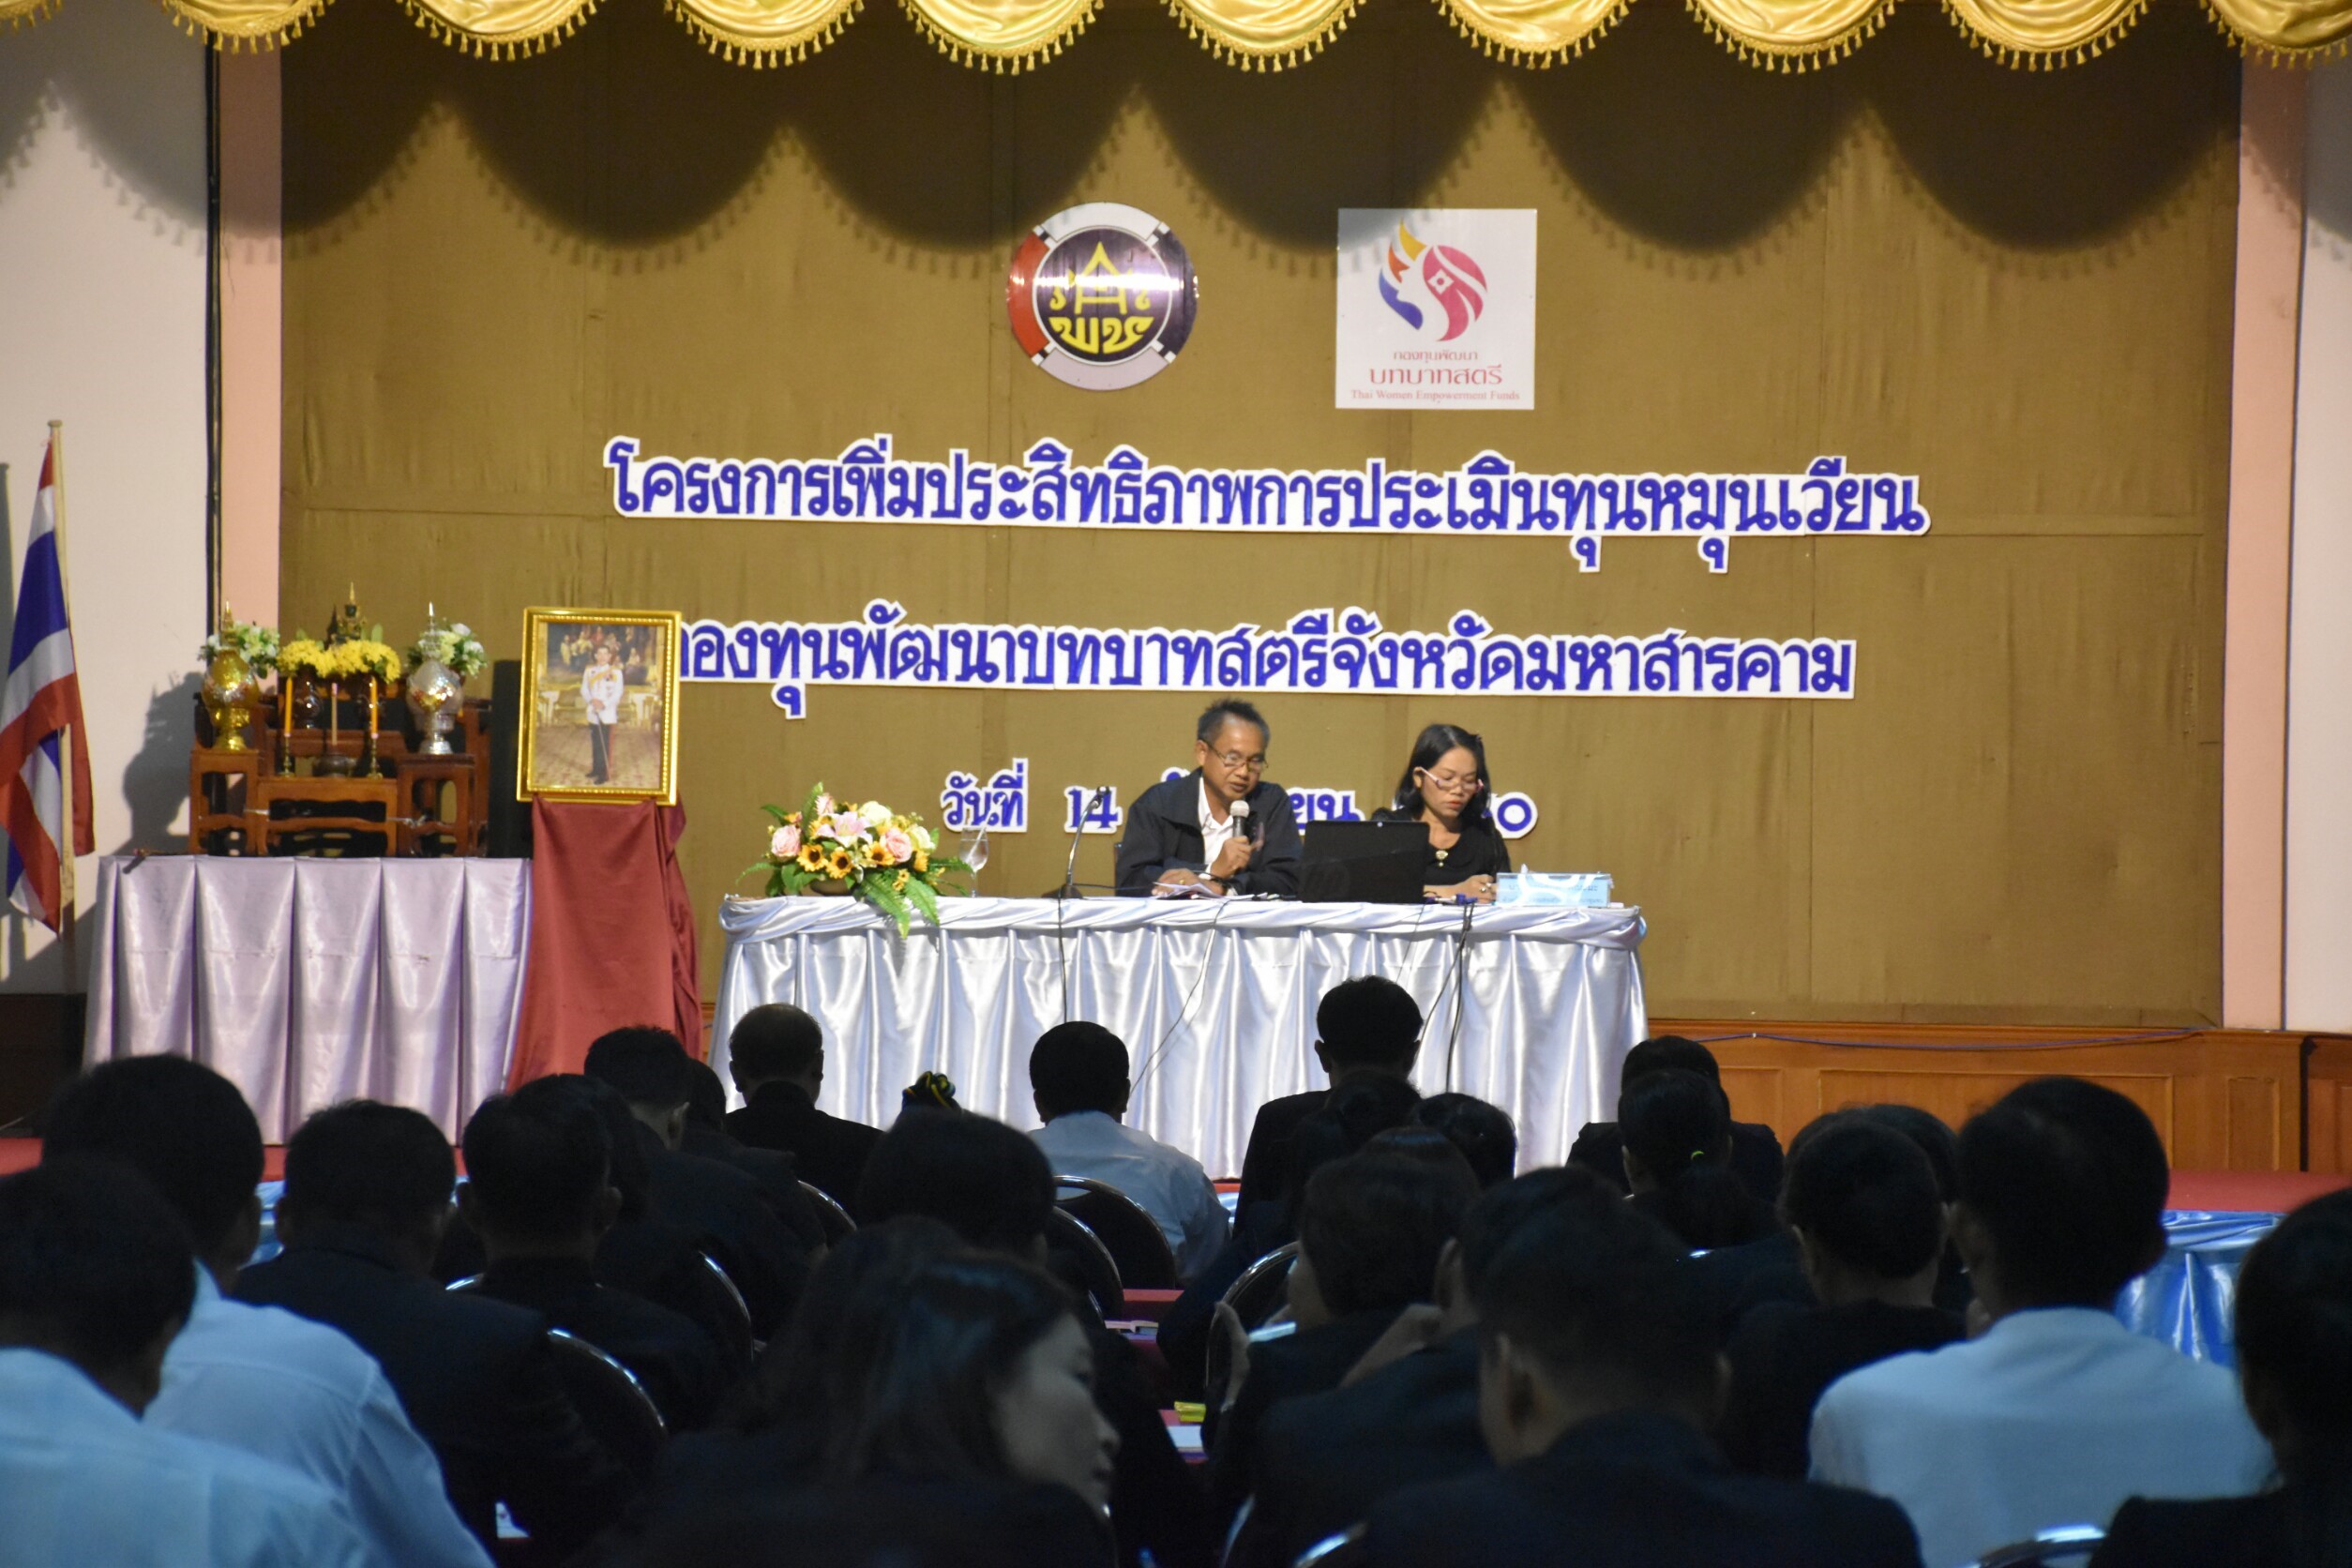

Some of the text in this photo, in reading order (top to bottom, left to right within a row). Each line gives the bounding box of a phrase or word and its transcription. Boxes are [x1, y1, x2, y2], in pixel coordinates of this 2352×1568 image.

[1394, 349, 1479, 364] กองทุนพัฒนา
[1369, 364, 1503, 385] บทบาทสตรี
[1350, 389, 1521, 401] Thai Women Empowerment Funds
[609, 437, 1925, 570] โครงการเพิ่มประสิทธิภาพการประเมินทุนหมุนเวียน
[942, 761, 1024, 827] วันที่
[1067, 786, 1119, 829] 14
